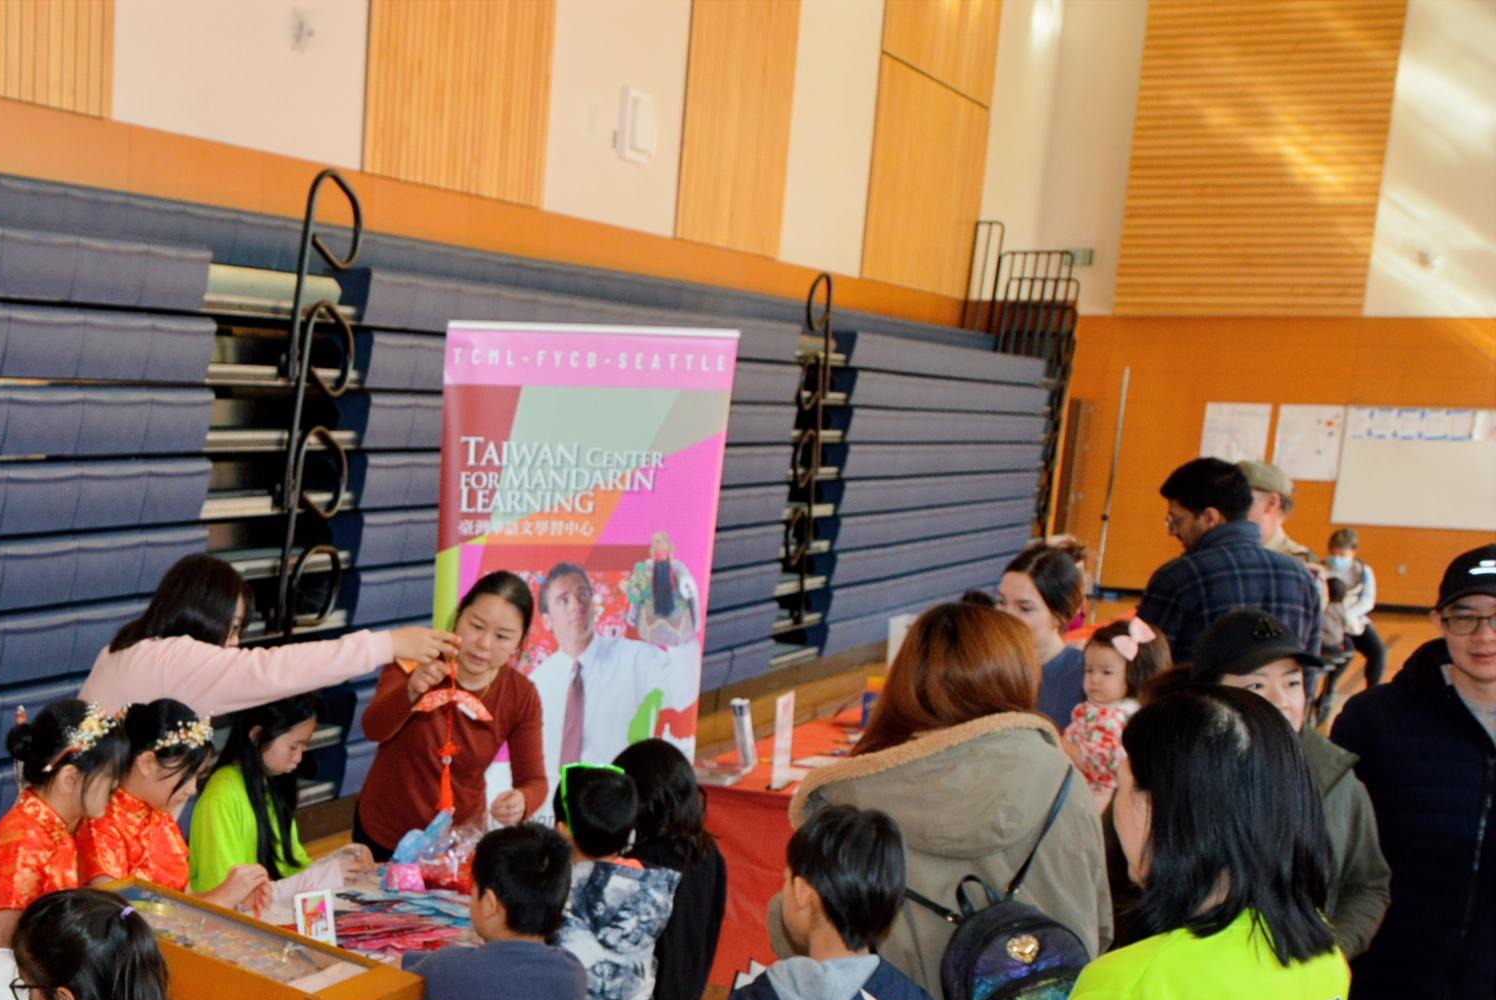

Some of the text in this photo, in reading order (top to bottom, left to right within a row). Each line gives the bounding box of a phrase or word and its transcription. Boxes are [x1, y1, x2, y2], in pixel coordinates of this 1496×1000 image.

[460, 436, 665, 468] TAIWAN CENTER
[460, 465, 655, 491] FOR MANDARIN
[460, 488, 594, 514] LEARNING
